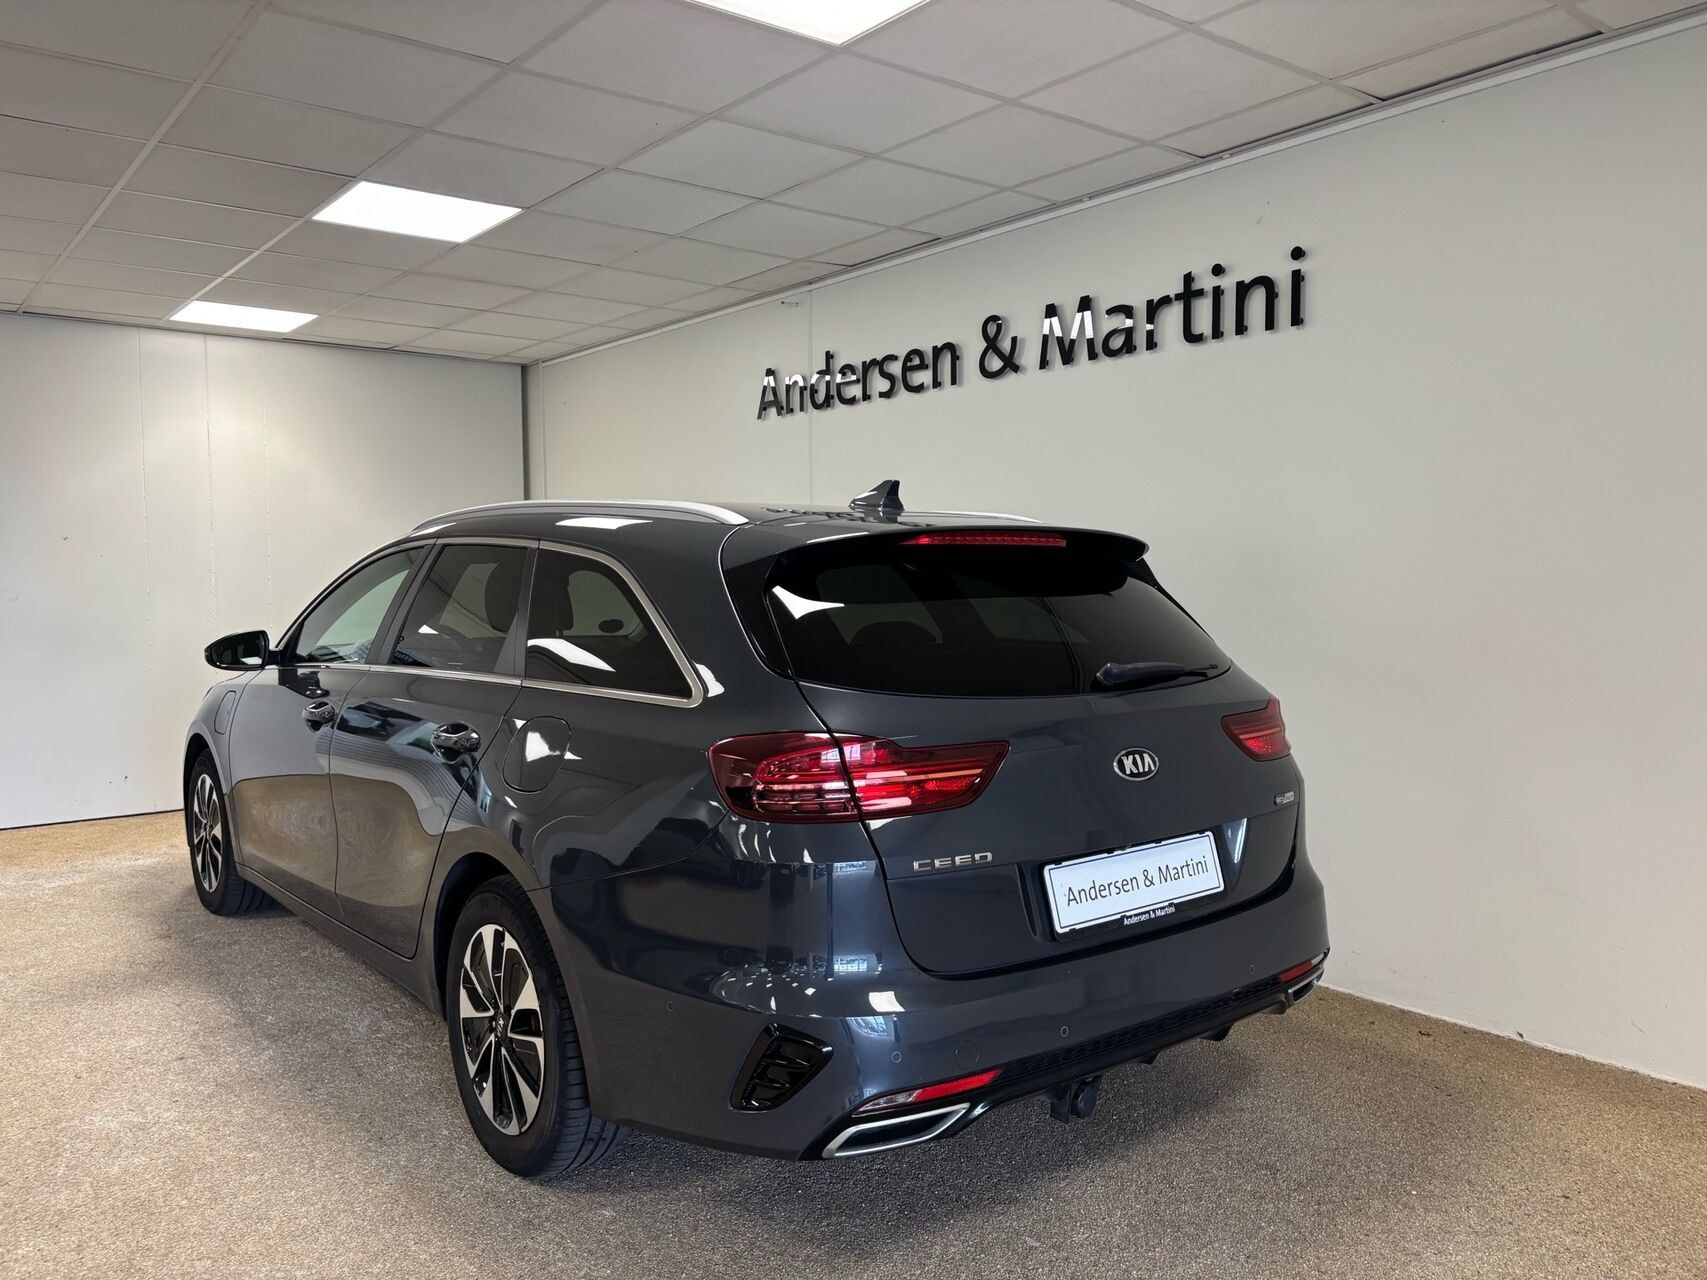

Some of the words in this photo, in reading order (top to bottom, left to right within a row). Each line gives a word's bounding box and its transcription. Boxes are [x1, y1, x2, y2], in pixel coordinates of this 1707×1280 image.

[757, 339, 959, 420] Andersen
[978, 314, 1020, 380] &
[1039, 246, 1306, 371] Martini
[1121, 753, 1155, 775] KIA
[913, 852, 992, 872] CEED
[1067, 876, 1140, 907] Andersen
[1142, 869, 1155, 888] &
[1158, 855, 1209, 884] Martini
[1123, 913, 1150, 926] Andersen
[1150, 910, 1155, 919] &
[1155, 904, 1176, 917] Martini
